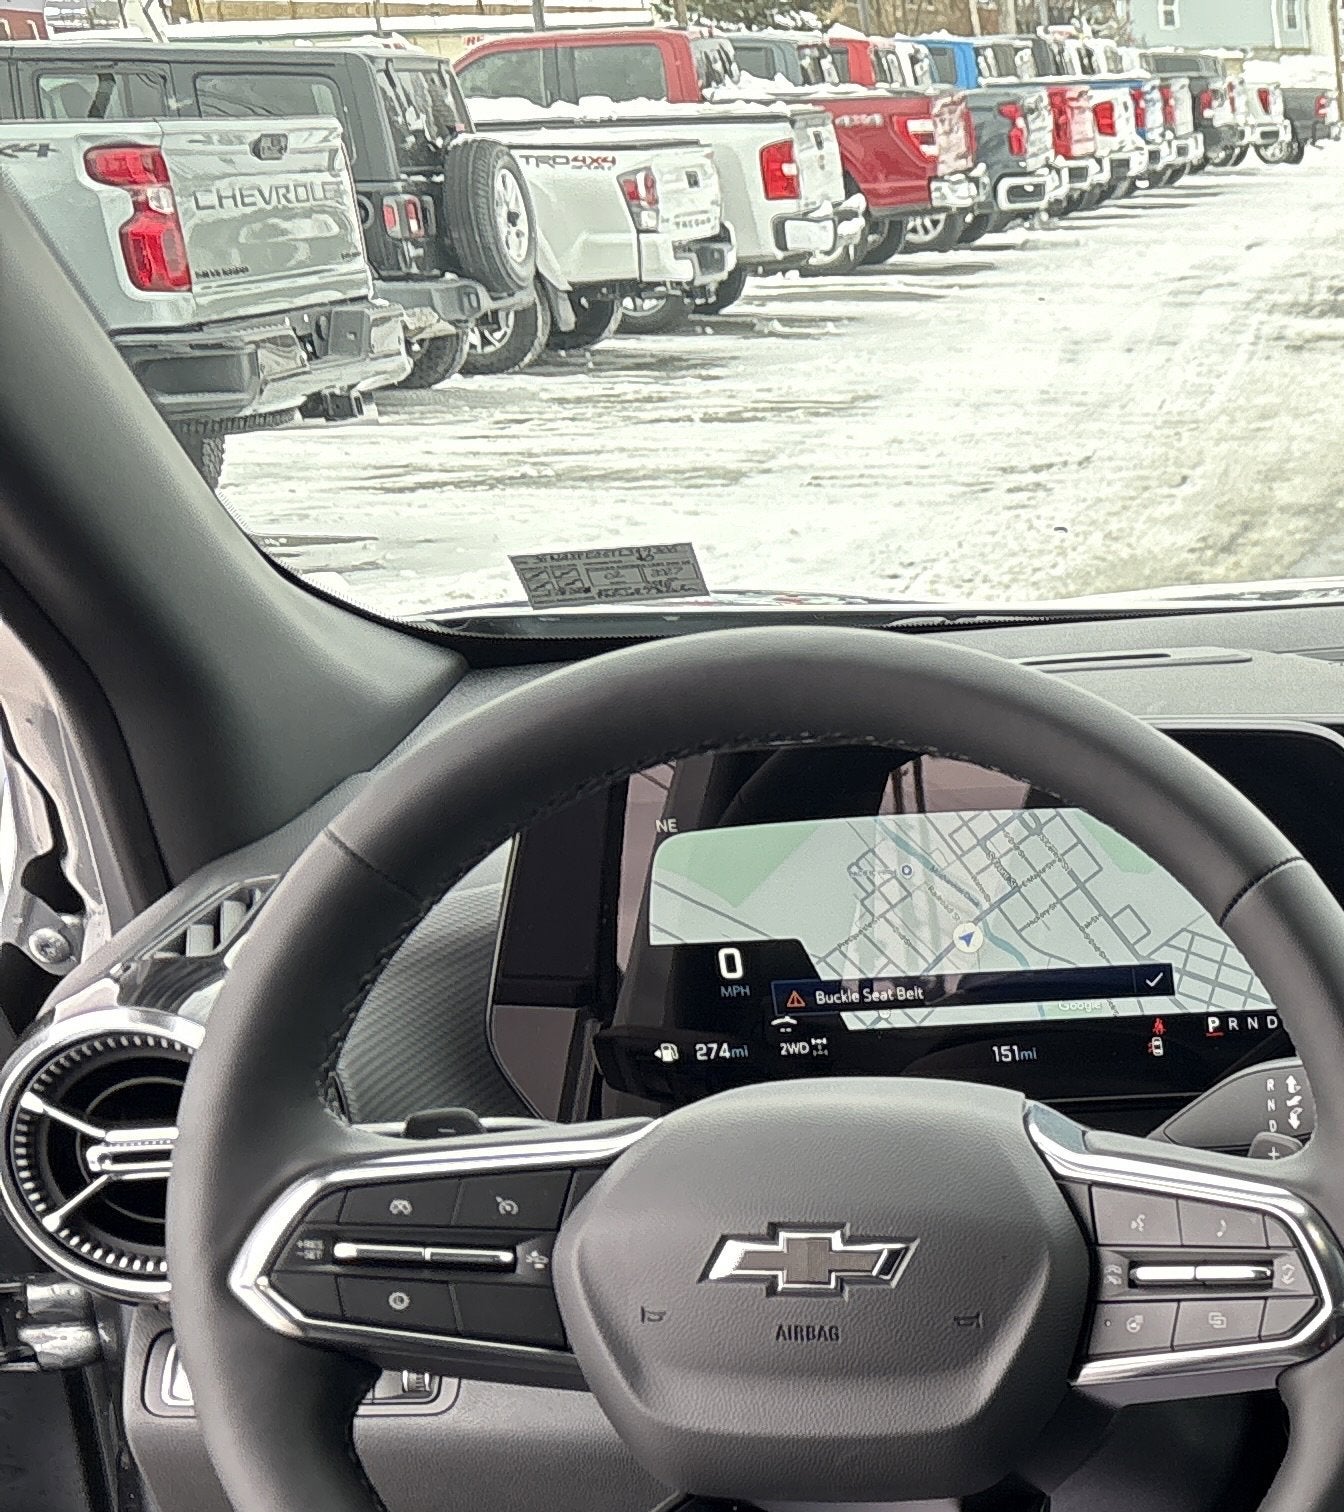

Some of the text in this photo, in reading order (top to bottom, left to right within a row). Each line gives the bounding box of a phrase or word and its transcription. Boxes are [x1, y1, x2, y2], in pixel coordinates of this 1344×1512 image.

[655, 818, 678, 833] NE
[718, 947, 744, 979] 0
[720, 985, 750, 998] MPH
[815, 985, 925, 1005] Buckle Seat Belt
[1207, 1015, 1278, 1032] P R N D
[780, 1041, 810, 1056] 2WD
[1266, 1078, 1275, 1091] R
[1267, 1098, 1276, 1111] N
[1268, 1119, 1277, 1132] D
[775, 1324, 840, 1341] AIRBAG
